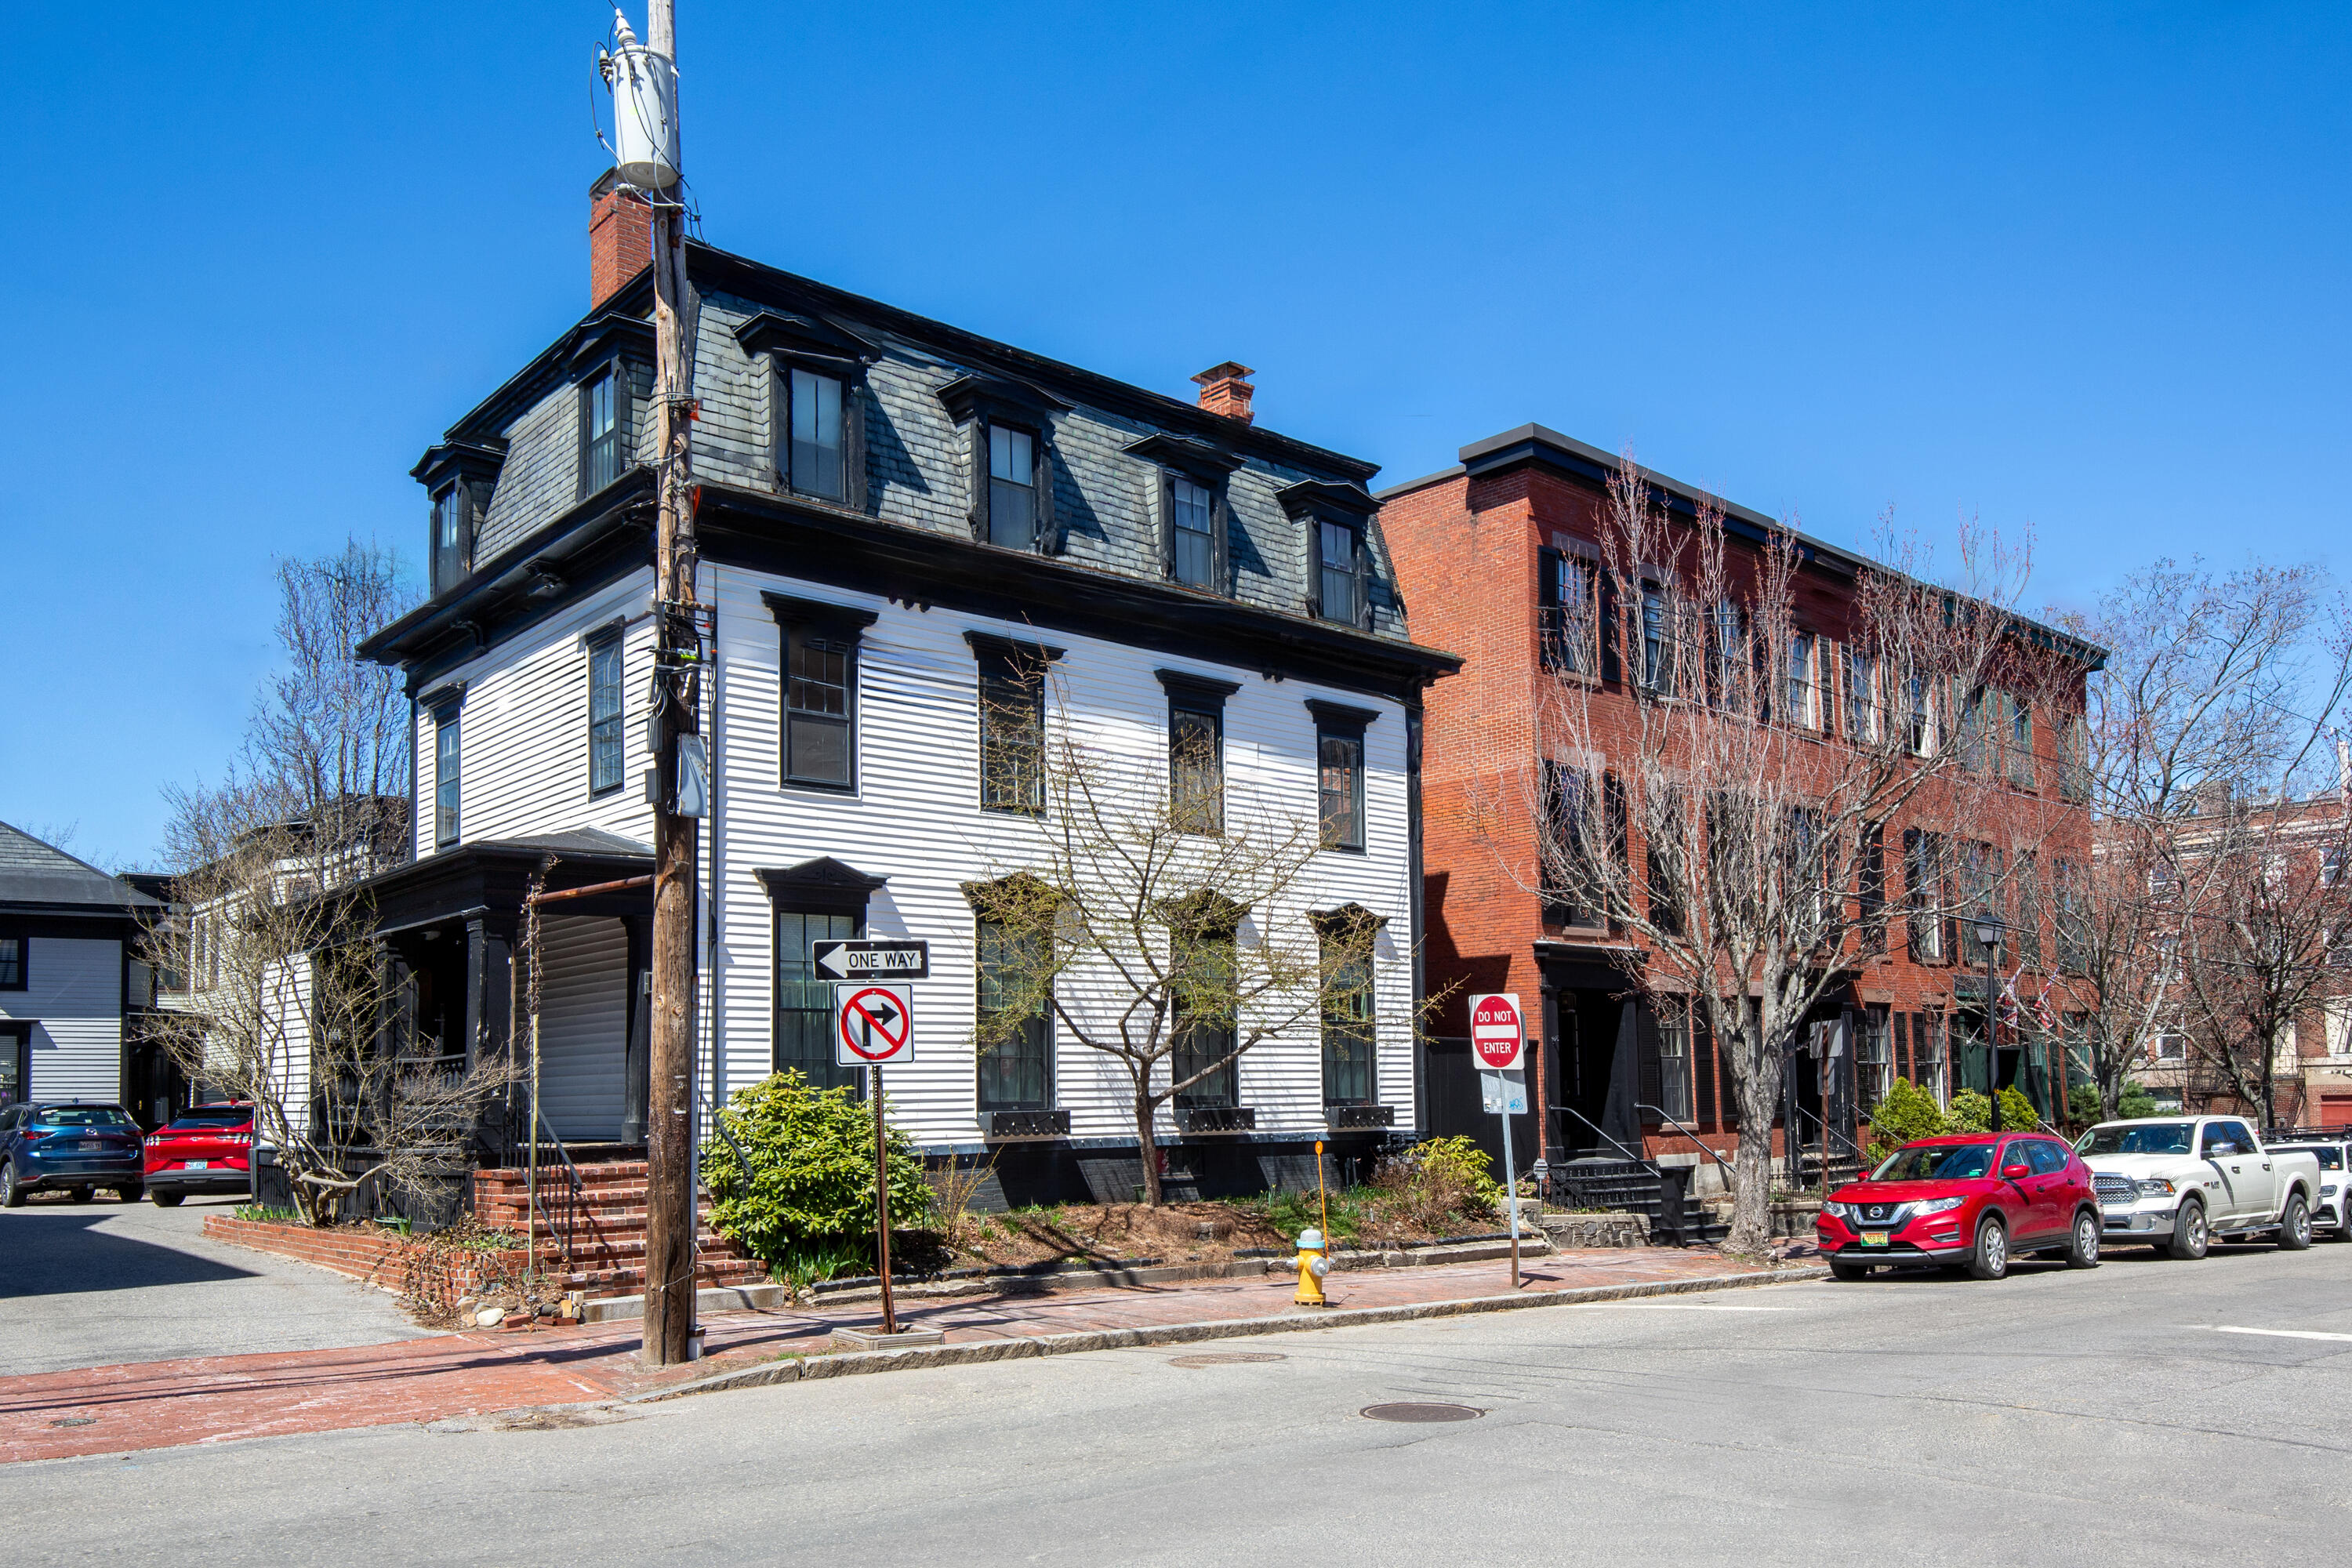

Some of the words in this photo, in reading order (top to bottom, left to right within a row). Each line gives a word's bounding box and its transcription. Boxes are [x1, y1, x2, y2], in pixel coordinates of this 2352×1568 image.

[848, 953, 879, 968] ONE
[884, 953, 916, 967] WAY
[1478, 1011, 1490, 1022] DO
[1494, 1011, 1512, 1022] NOT
[1483, 1042, 1512, 1054] ENTER
